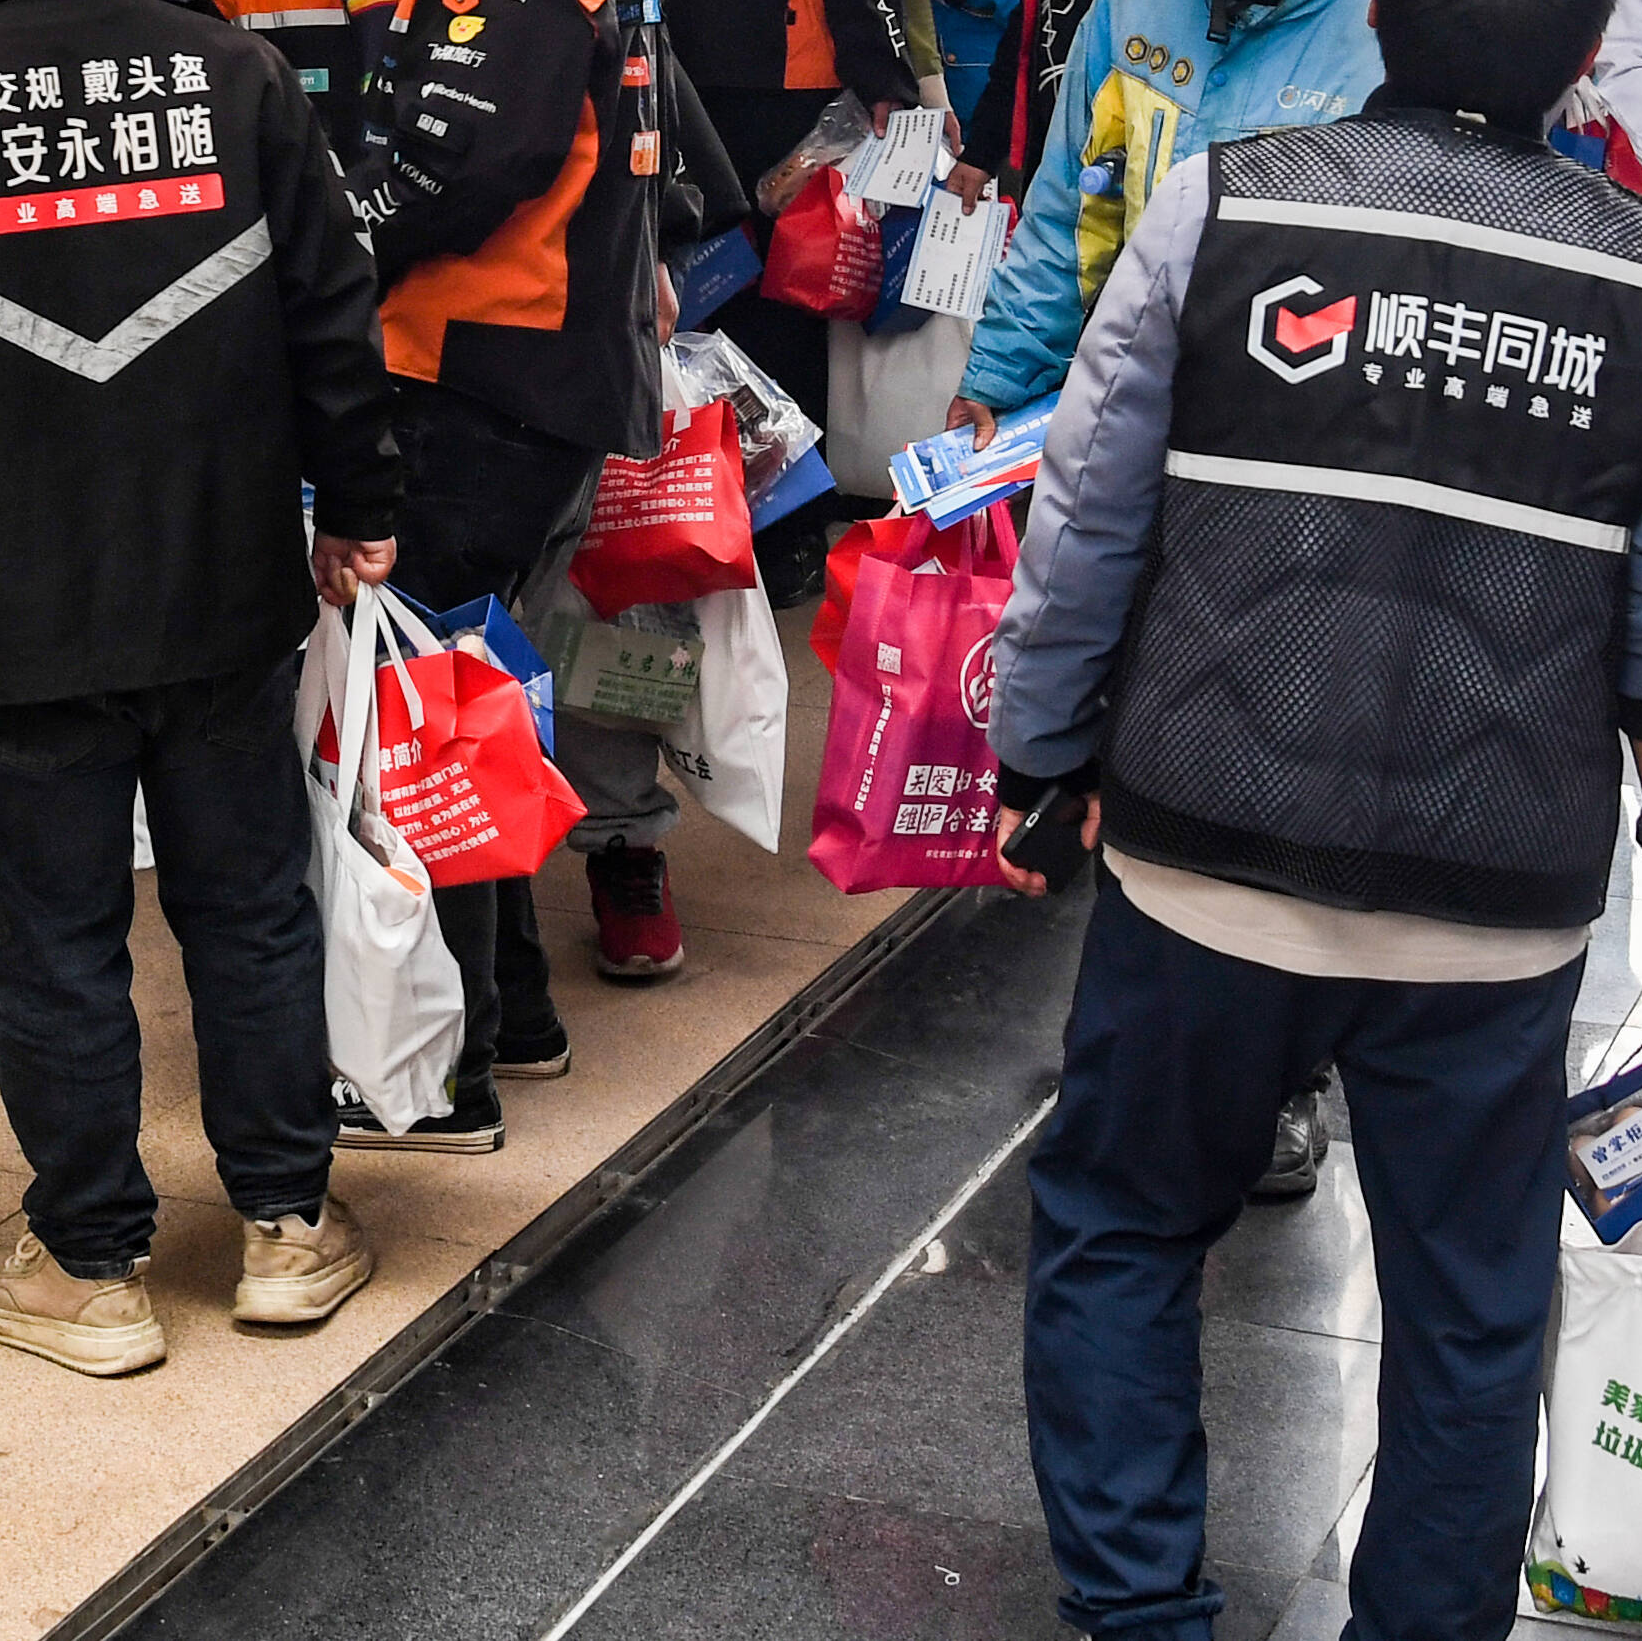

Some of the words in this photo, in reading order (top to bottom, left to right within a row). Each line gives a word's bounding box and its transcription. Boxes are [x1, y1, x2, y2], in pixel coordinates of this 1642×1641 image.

[81, 52, 211, 106] 戴头盔
[1364, 289, 1607, 399] 顺丰同城
[1362, 362, 1593, 430] 专业高端急送
